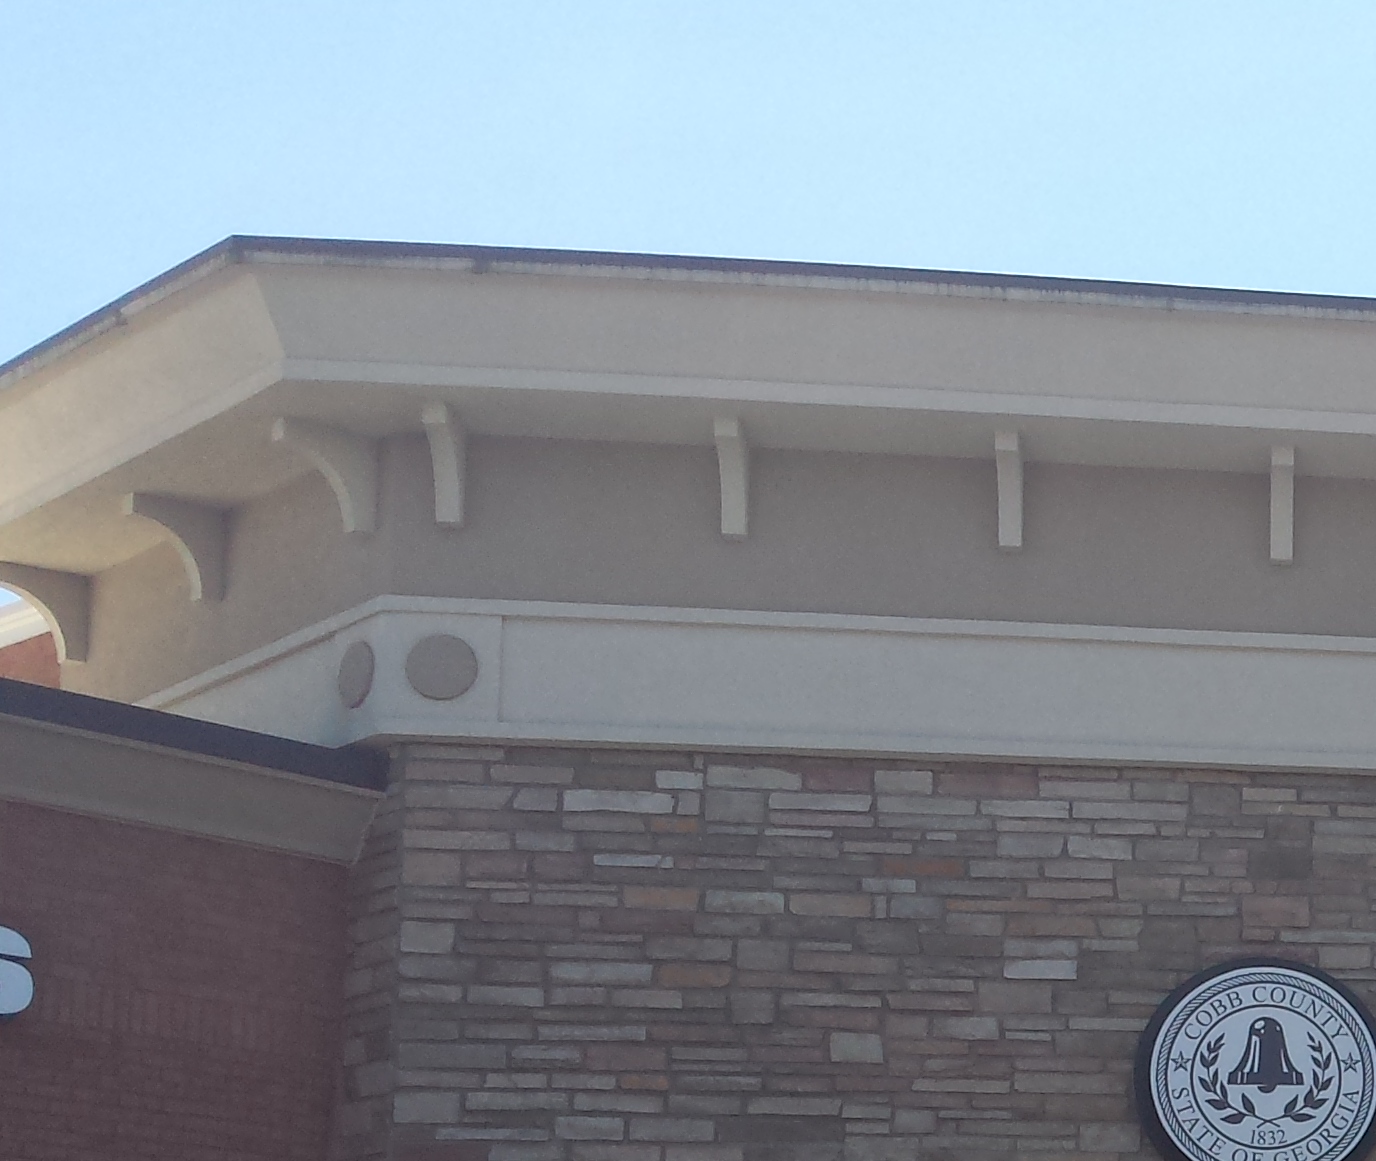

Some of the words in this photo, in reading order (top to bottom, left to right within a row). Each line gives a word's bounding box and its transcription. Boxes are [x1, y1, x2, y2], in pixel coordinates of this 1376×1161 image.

[1184, 991, 1242, 1041] COBB
[1252, 985, 1350, 1041] COUNTY
[1172, 1086, 1225, 1156] STATE
[1249, 1128, 1288, 1146] 1832
